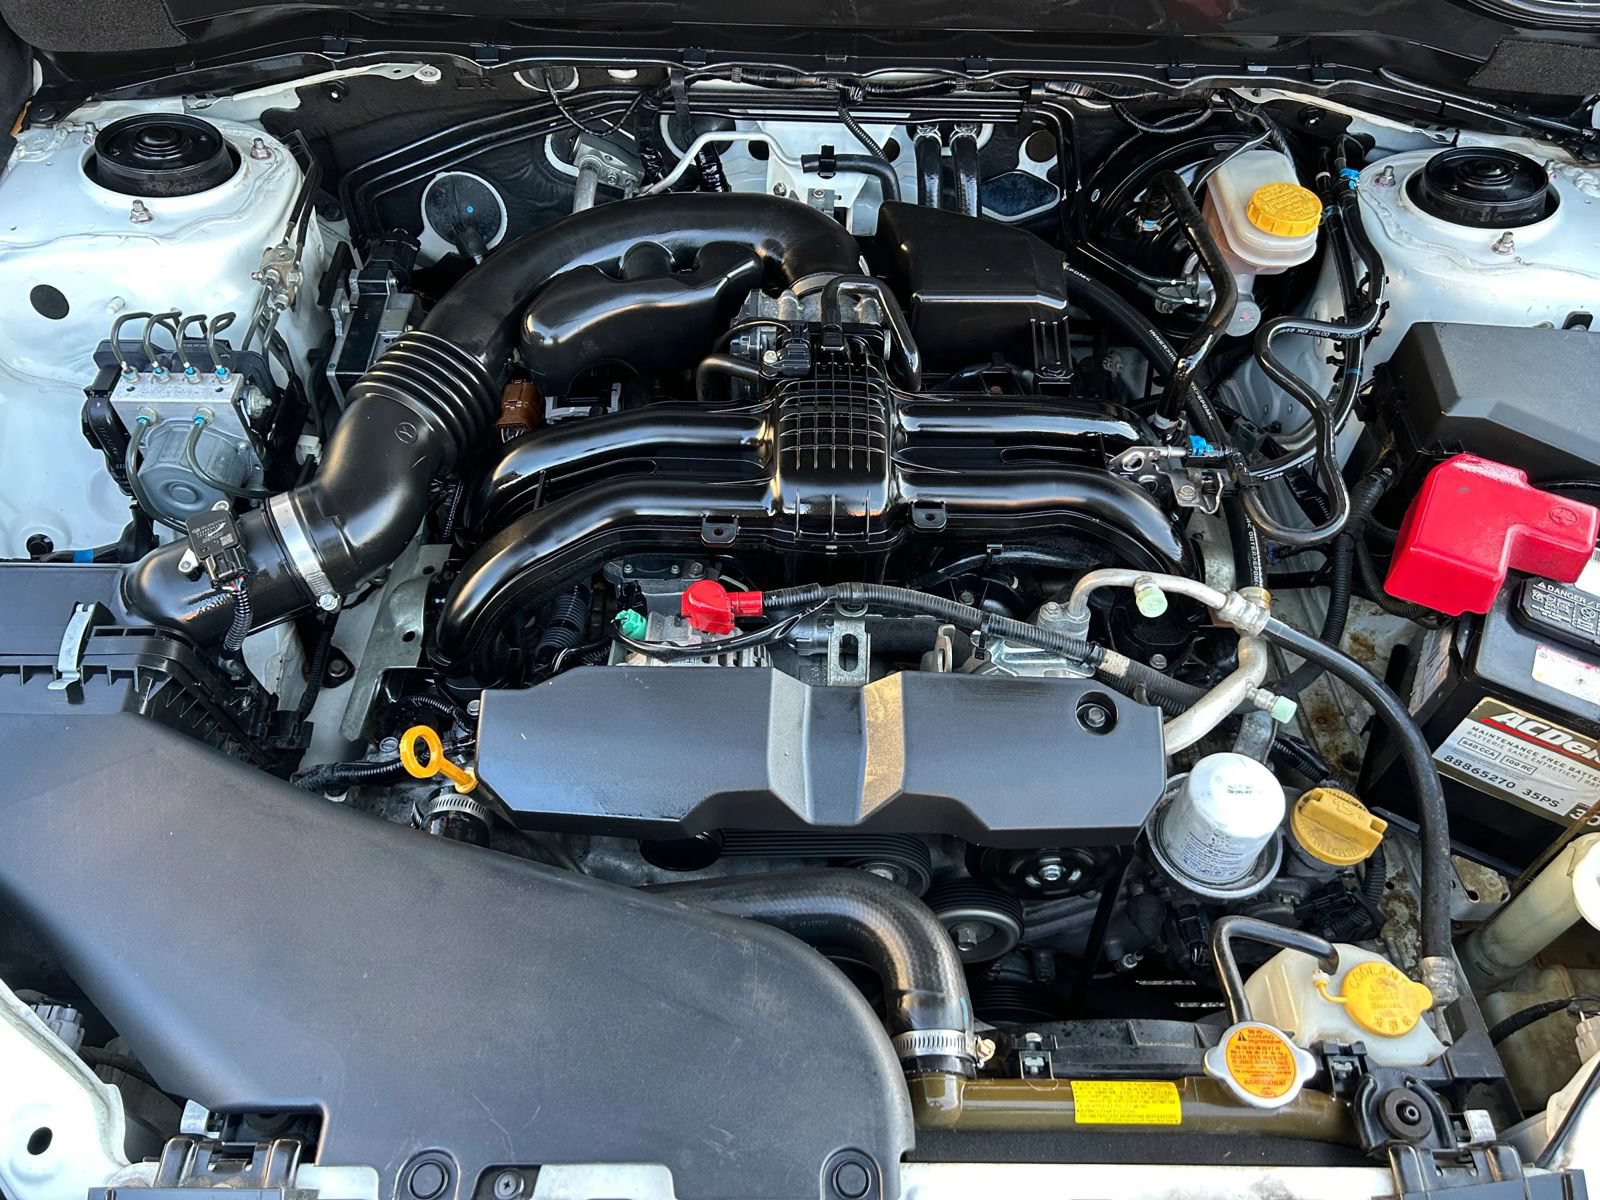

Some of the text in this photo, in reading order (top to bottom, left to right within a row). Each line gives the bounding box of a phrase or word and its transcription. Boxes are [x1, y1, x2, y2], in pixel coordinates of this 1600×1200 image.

[1547, 584, 1586, 605] DANGER
[1462, 740, 1495, 757] 640 CCA
[1466, 730, 1505, 750] BATTERIE
[1471, 726, 1539, 758] MAINTENANCE
[1541, 755, 1567, 768] FREE
[1568, 766, 1600, 783] BATTE
[1505, 758, 1533, 772] 100 RC
[1443, 755, 1516, 789] 88865270
[1521, 788, 1560, 808] 35PS
